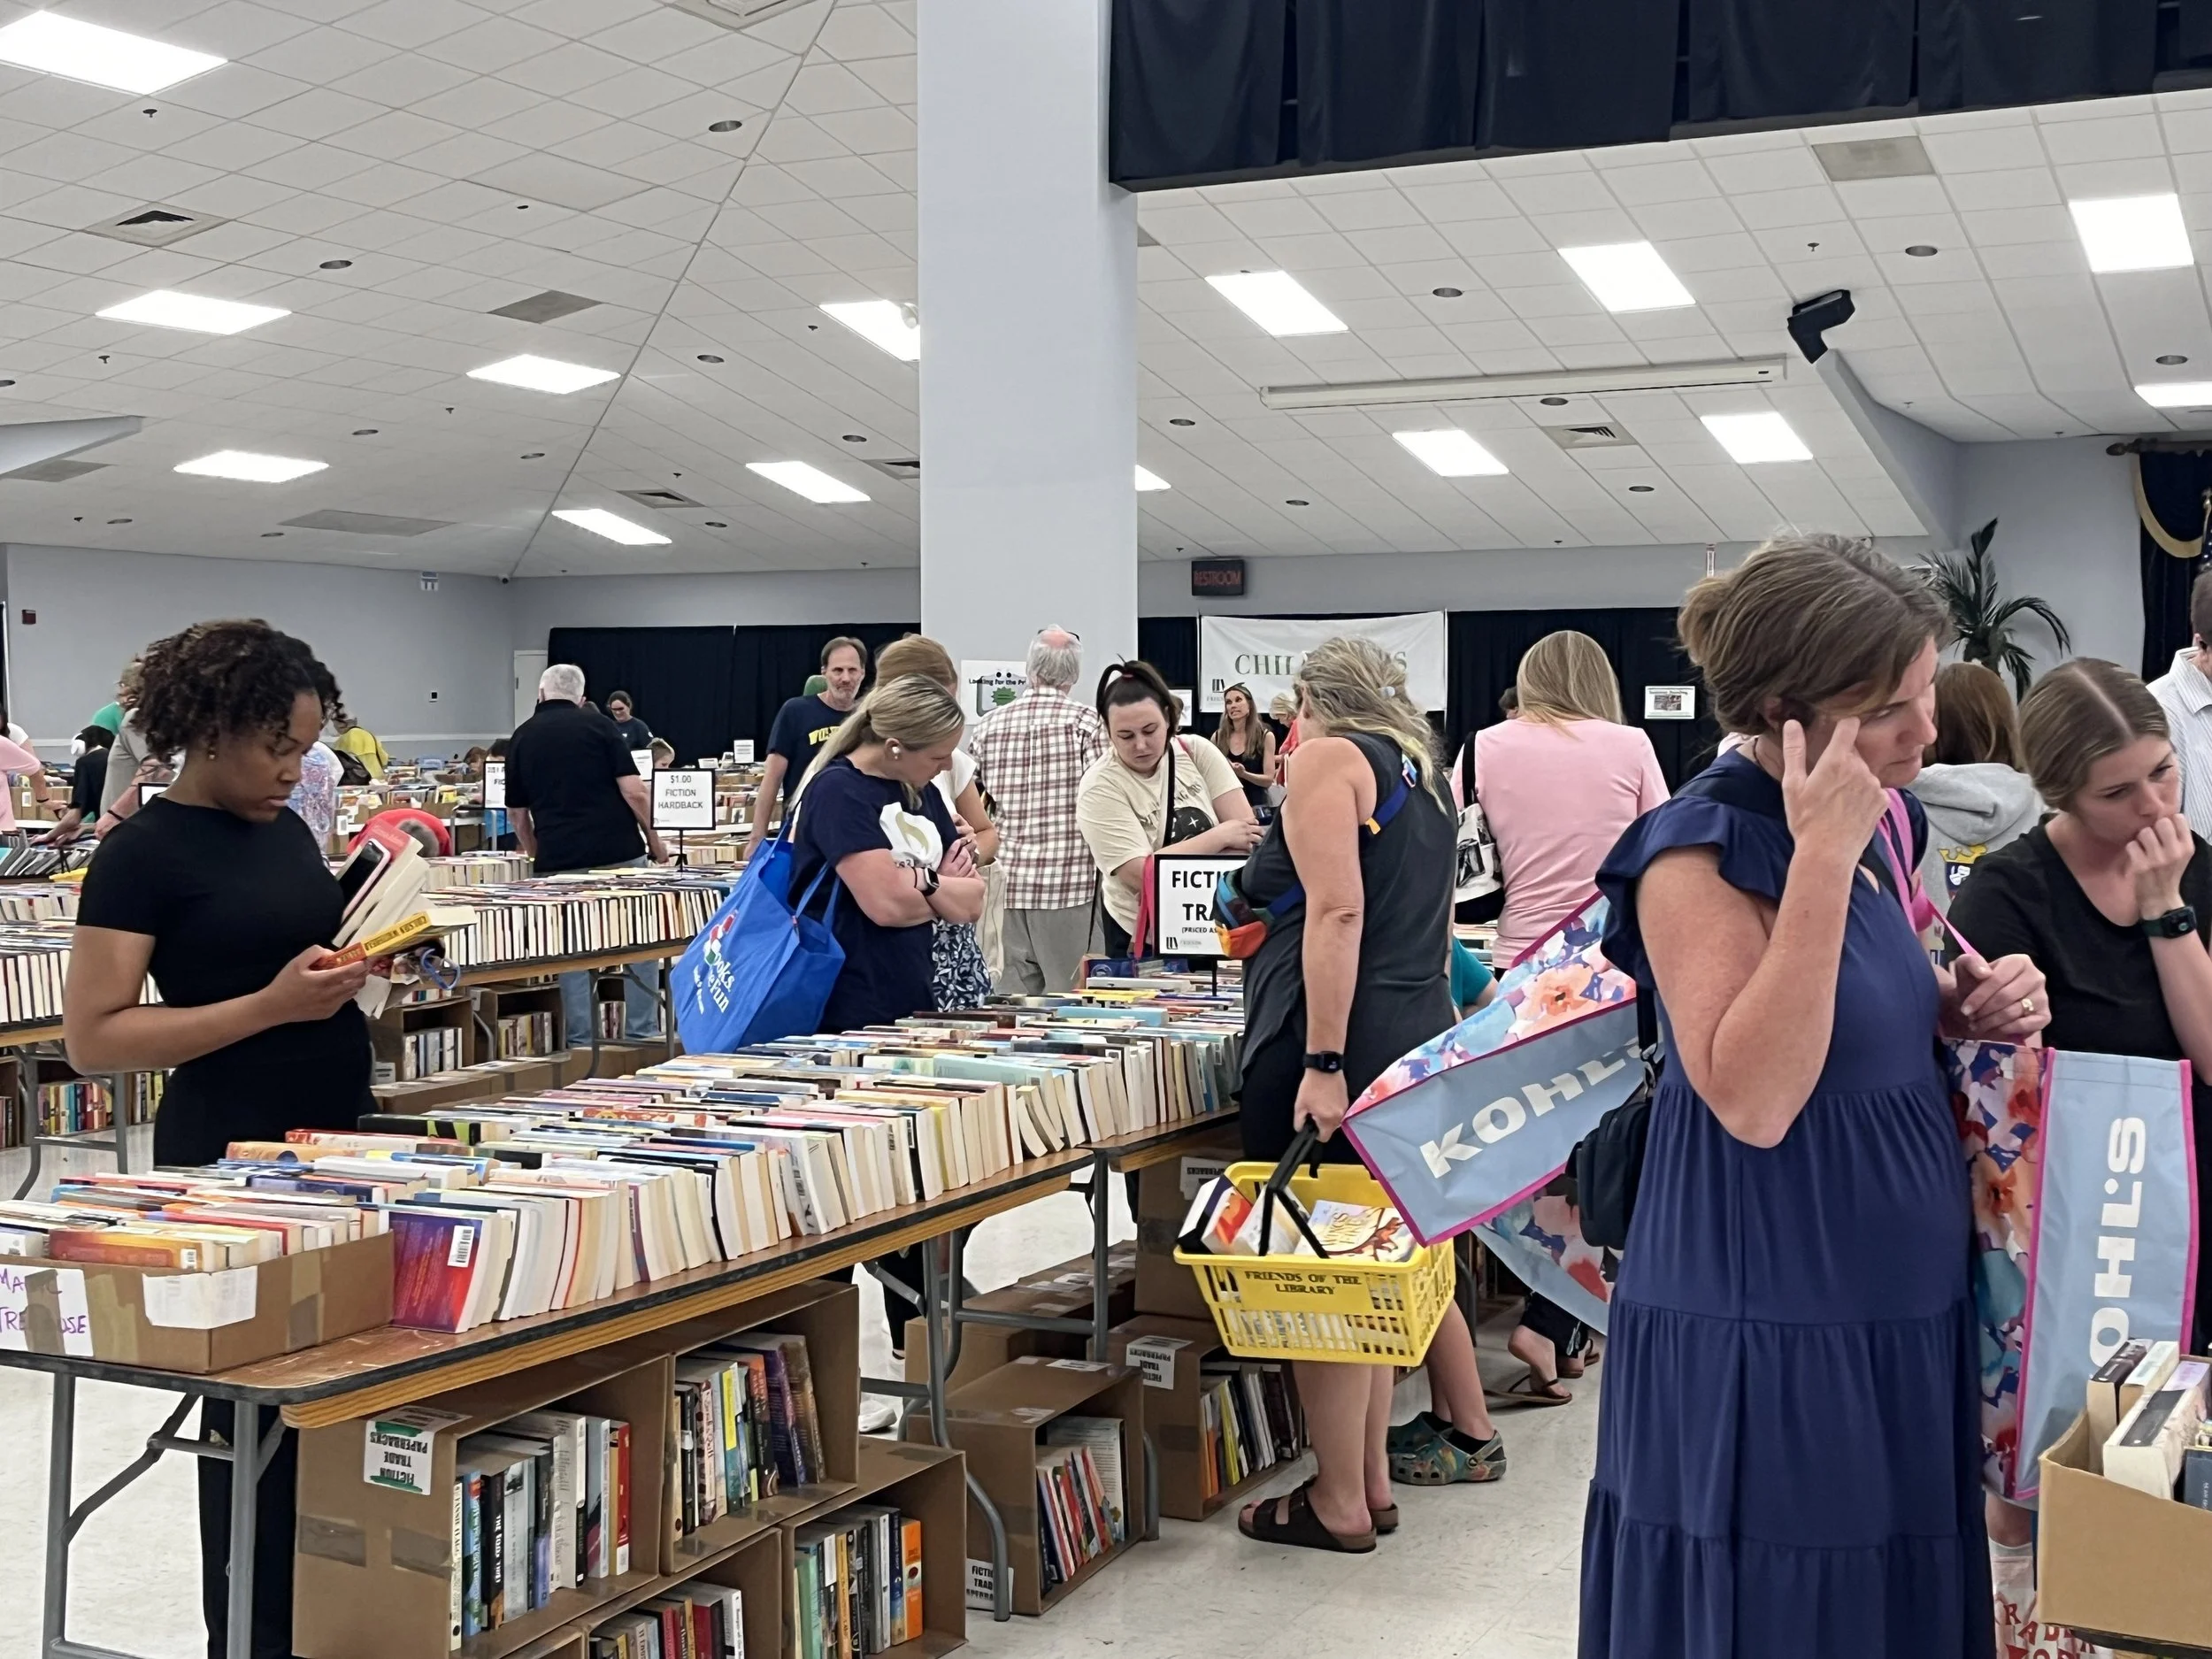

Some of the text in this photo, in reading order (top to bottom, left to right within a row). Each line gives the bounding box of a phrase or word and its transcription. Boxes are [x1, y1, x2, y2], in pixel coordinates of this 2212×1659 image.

[1194, 571, 1240, 585] RESTROOM
[670, 774, 692, 784] $1.00
[665, 788, 696, 797] FICTION
[1171, 871, 1226, 888] FICTI
[1419, 1036, 1642, 1179] KOHL
[2089, 1117, 2147, 1379] OHL'S
[1244, 1271, 1363, 1285] FRIENDS OF THE
[1275, 1284, 1335, 1294] LIBRARY
[370, 1432, 428, 1454] PAPERBACKS
[383, 1451, 411, 1468] TRADE
[972, 1565, 994, 1578] FICTI
[974, 1578, 993, 1590] TRAD
